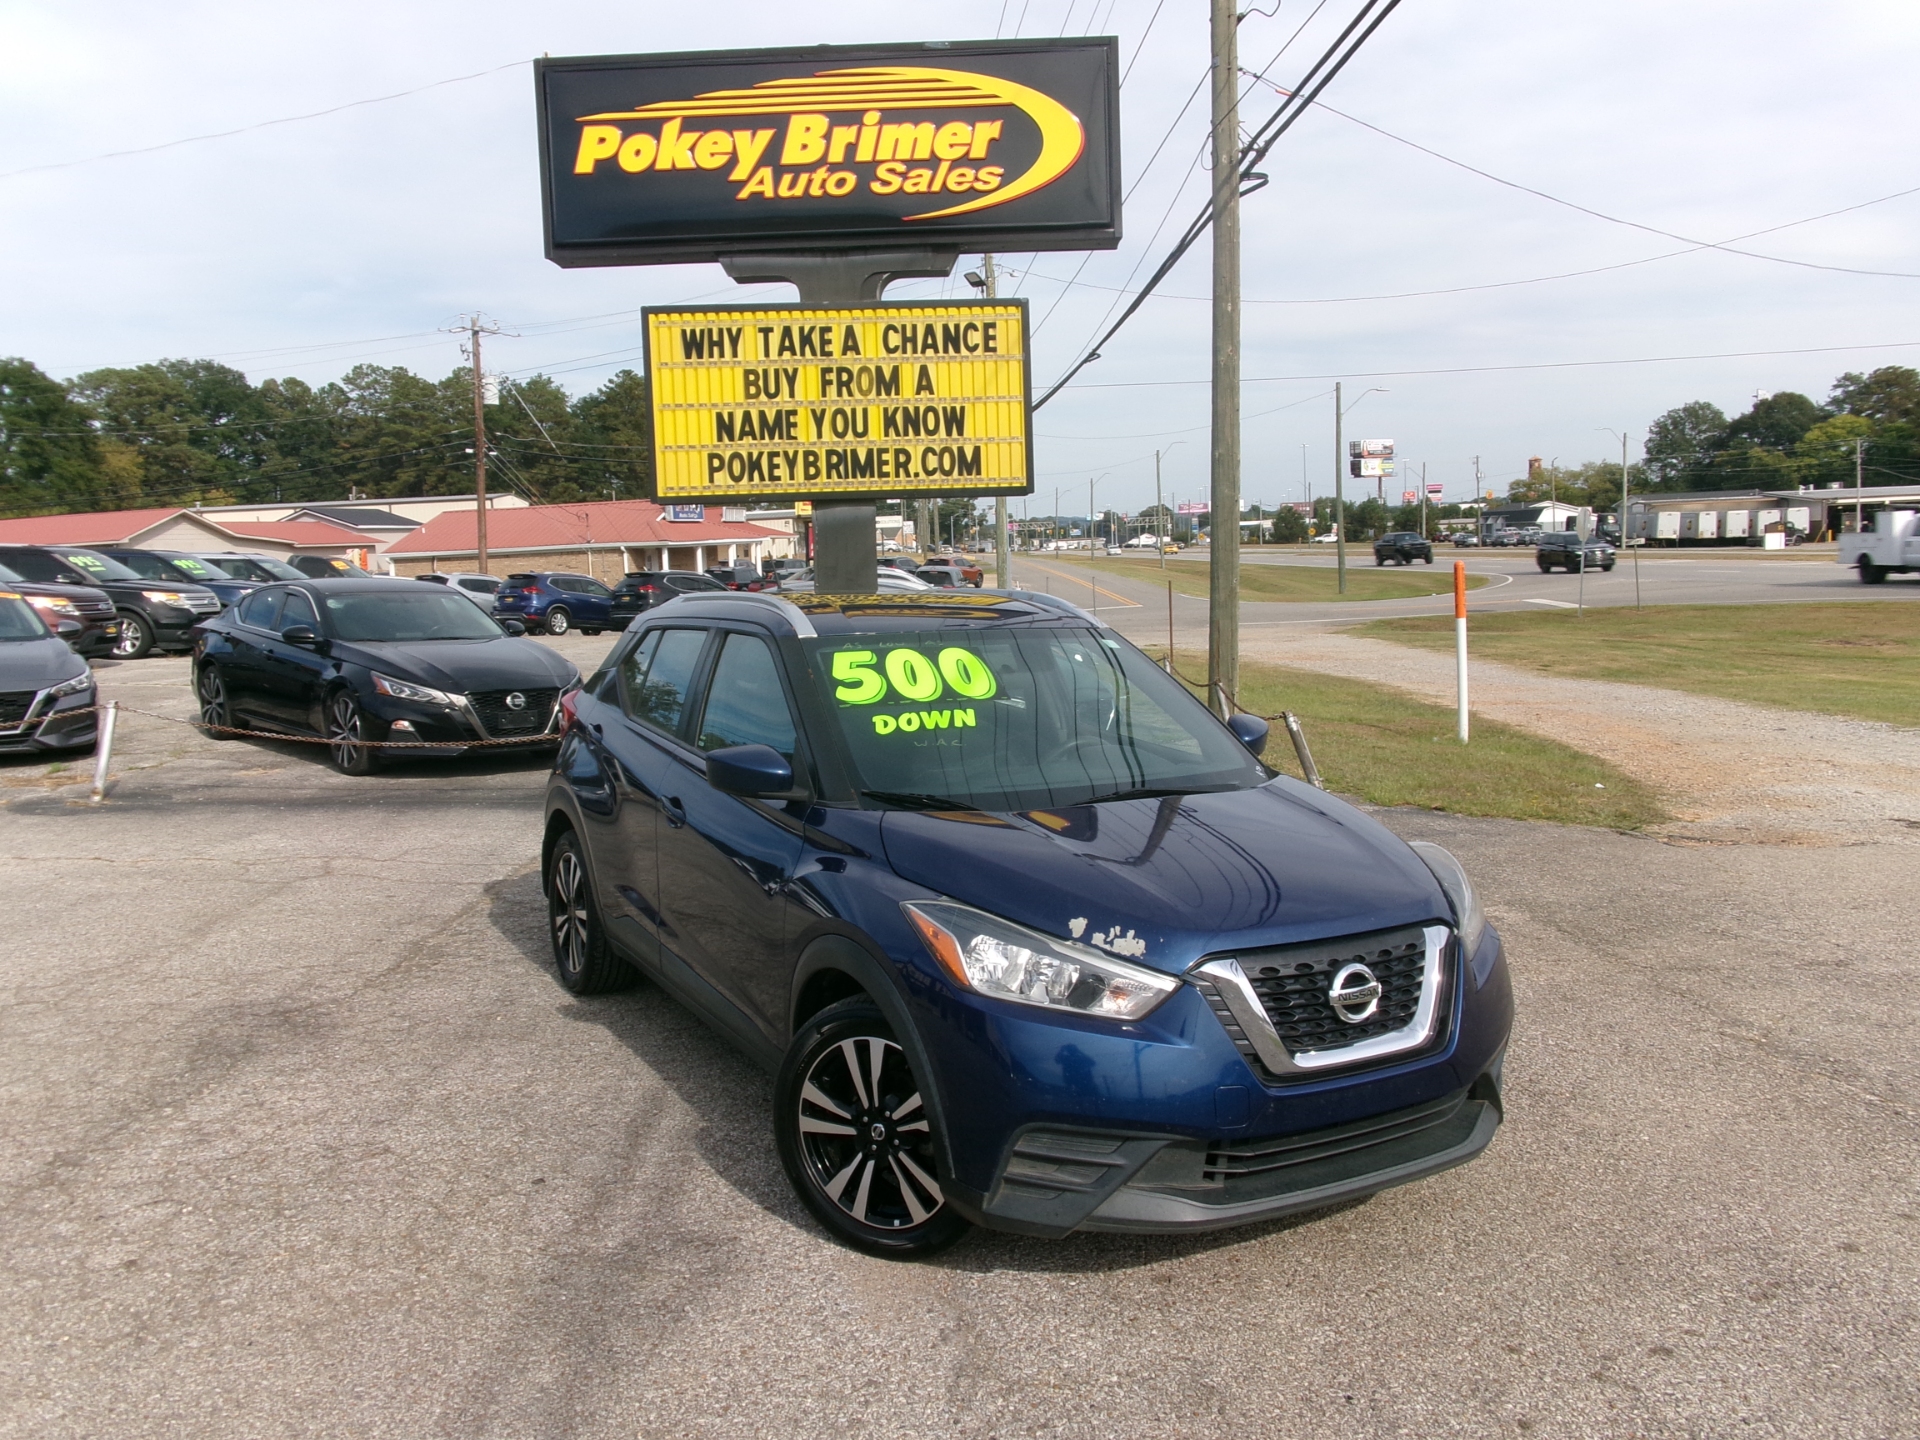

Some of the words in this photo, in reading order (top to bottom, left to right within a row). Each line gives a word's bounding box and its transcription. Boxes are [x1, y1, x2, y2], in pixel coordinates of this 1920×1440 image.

[573, 117, 778, 182] Pokey
[779, 110, 1004, 166] Brimer
[735, 165, 858, 200] Auto
[868, 159, 1006, 195] Sales
[681, 327, 743, 360] WHY
[758, 325, 834, 358] TAKE
[841, 324, 862, 356] A
[882, 322, 998, 355] CHANCE
[743, 366, 799, 400] BUY
[820, 364, 900, 398] FROM
[915, 364, 935, 396] A
[715, 409, 798, 442] NAME
[810, 407, 868, 440] YOU
[883, 405, 966, 437] KNOW
[707, 445, 982, 484] POKEYBRIMER.COM
[832, 647, 997, 705] 500
[872, 708, 976, 735] DOWN
[1338, 987, 1380, 1002] NISSAN
